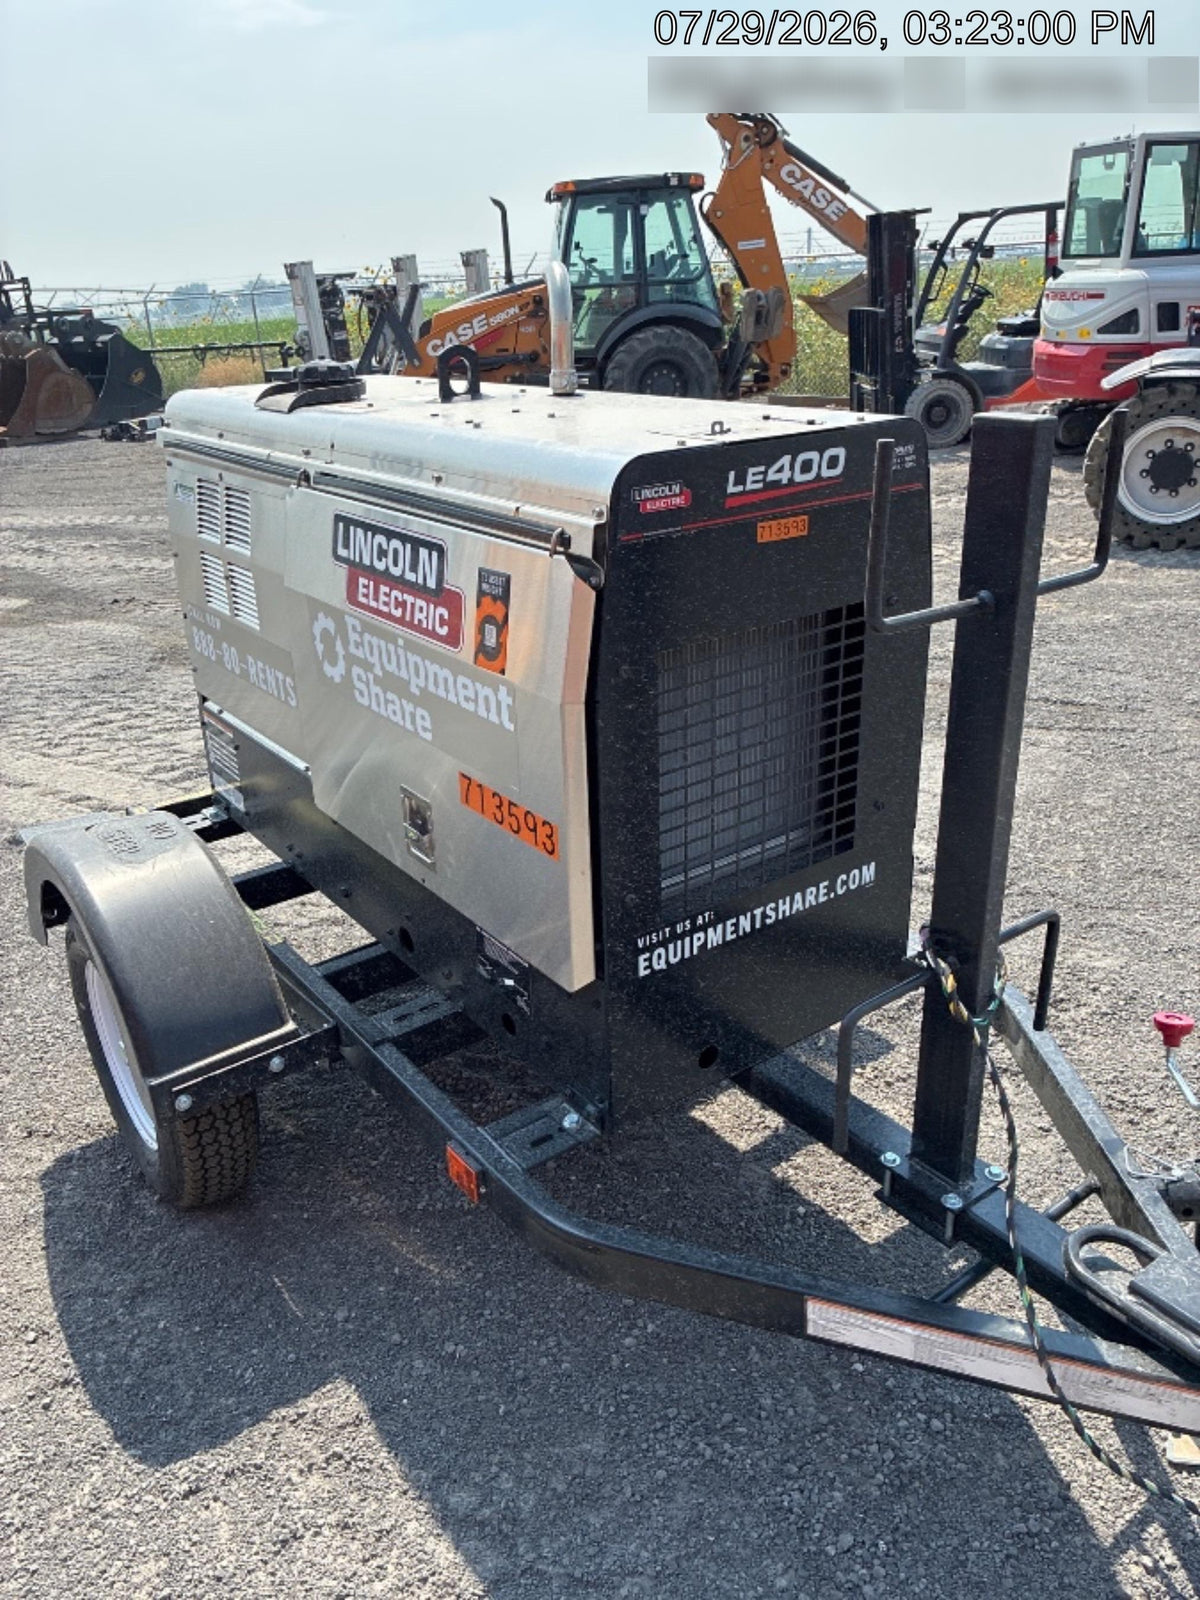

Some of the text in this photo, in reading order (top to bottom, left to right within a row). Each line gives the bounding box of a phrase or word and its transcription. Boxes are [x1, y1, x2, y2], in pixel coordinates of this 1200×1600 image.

[780, 163, 848, 221] CASE
[426, 313, 488, 357] CASE
[634, 483, 681, 501] LINCOLN
[727, 449, 846, 494] LE400
[336, 521, 439, 590] LINCOLN
[759, 518, 808, 541] 713593
[357, 576, 449, 636] ELECTRIC
[192, 625, 297, 707] 888-80-RENTS
[344, 614, 515, 732] Equipment
[351, 665, 433, 742] Share
[459, 772, 556, 857] 713593
[637, 861, 877, 978] EQUIPMENTSHARE.COM
[637, 911, 715, 949] VISIT US AT:
